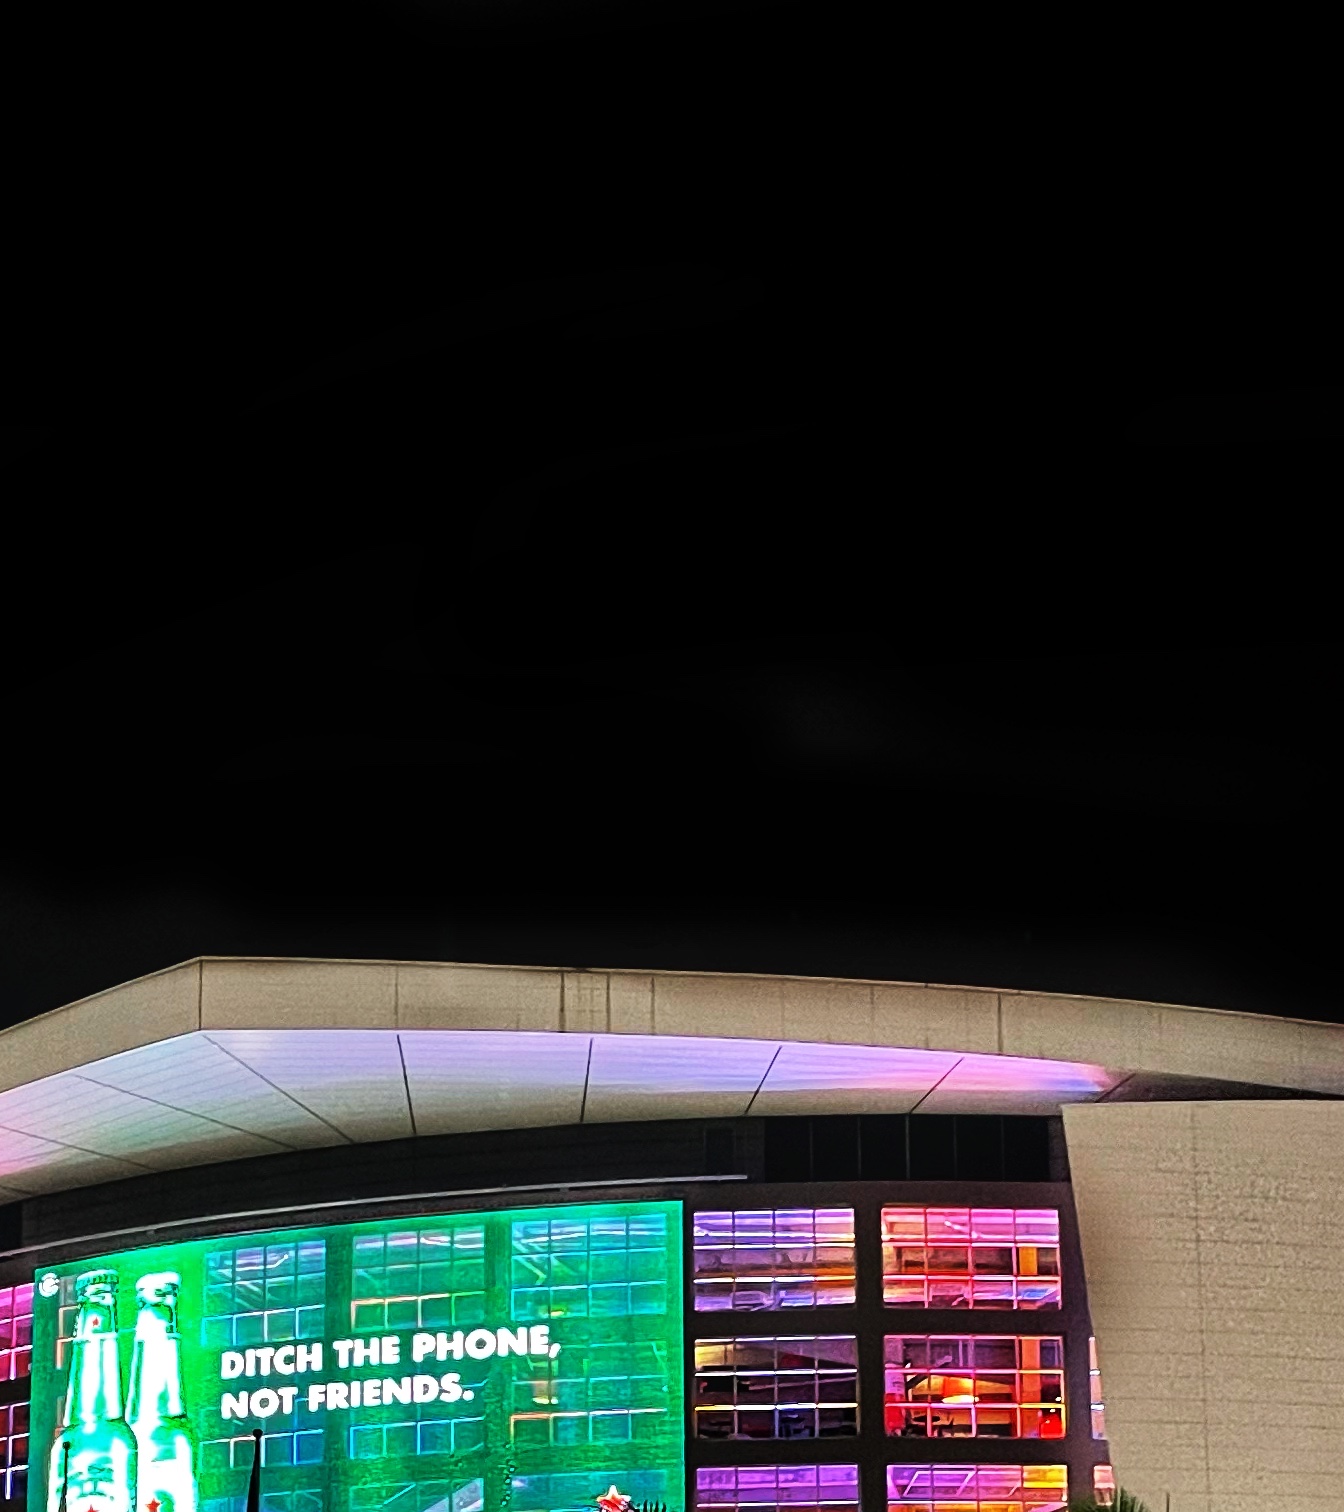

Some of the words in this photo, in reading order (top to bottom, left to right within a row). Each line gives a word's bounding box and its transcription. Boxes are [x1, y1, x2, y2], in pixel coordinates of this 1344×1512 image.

[221, 1342, 323, 1379] DITCH
[333, 1335, 400, 1368] THE
[412, 1325, 561, 1363] PHONE,
[221, 1386, 298, 1419] NOT
[308, 1373, 475, 1412] FRIENDS.
